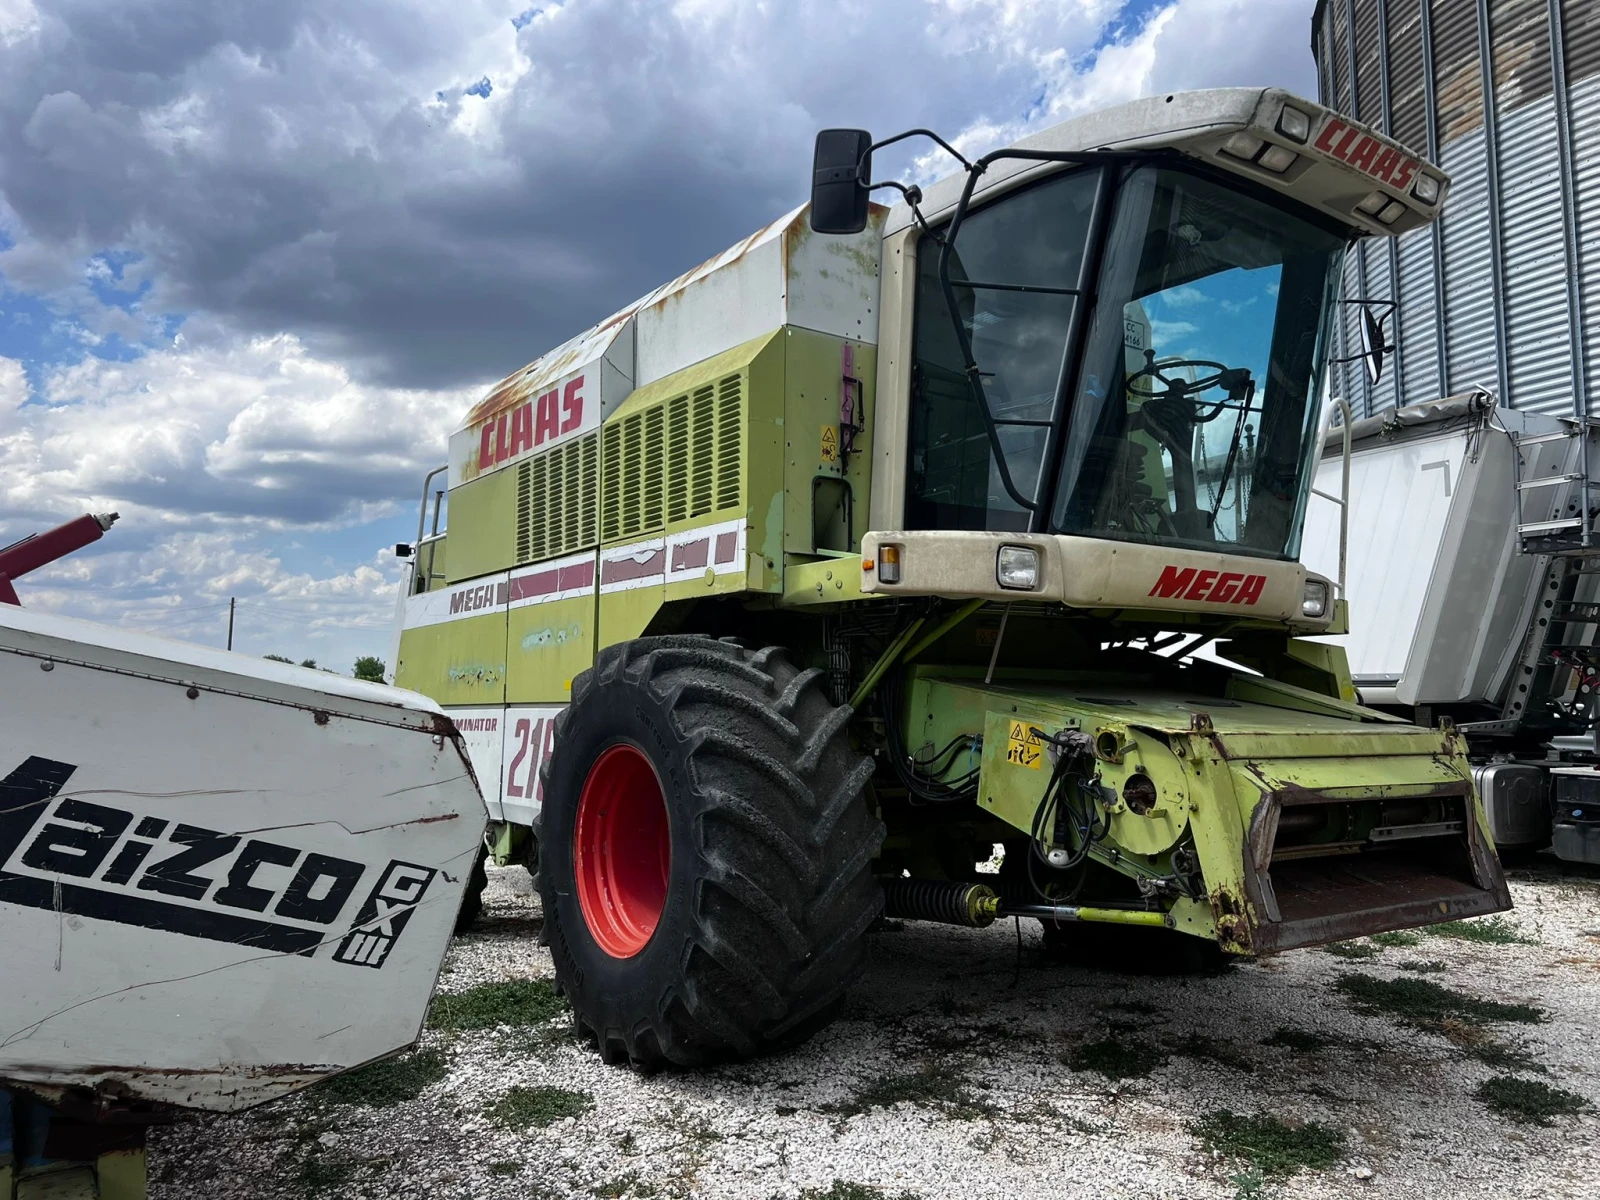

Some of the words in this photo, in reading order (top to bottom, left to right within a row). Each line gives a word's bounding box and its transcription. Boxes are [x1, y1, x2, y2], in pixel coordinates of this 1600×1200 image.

[1314, 119, 1420, 190] CLAAS
[478, 374, 585, 470] CLAAS
[449, 584, 494, 615] MEGA
[1148, 565, 1267, 605] MEGA
[452, 718, 498, 732] MINATOR
